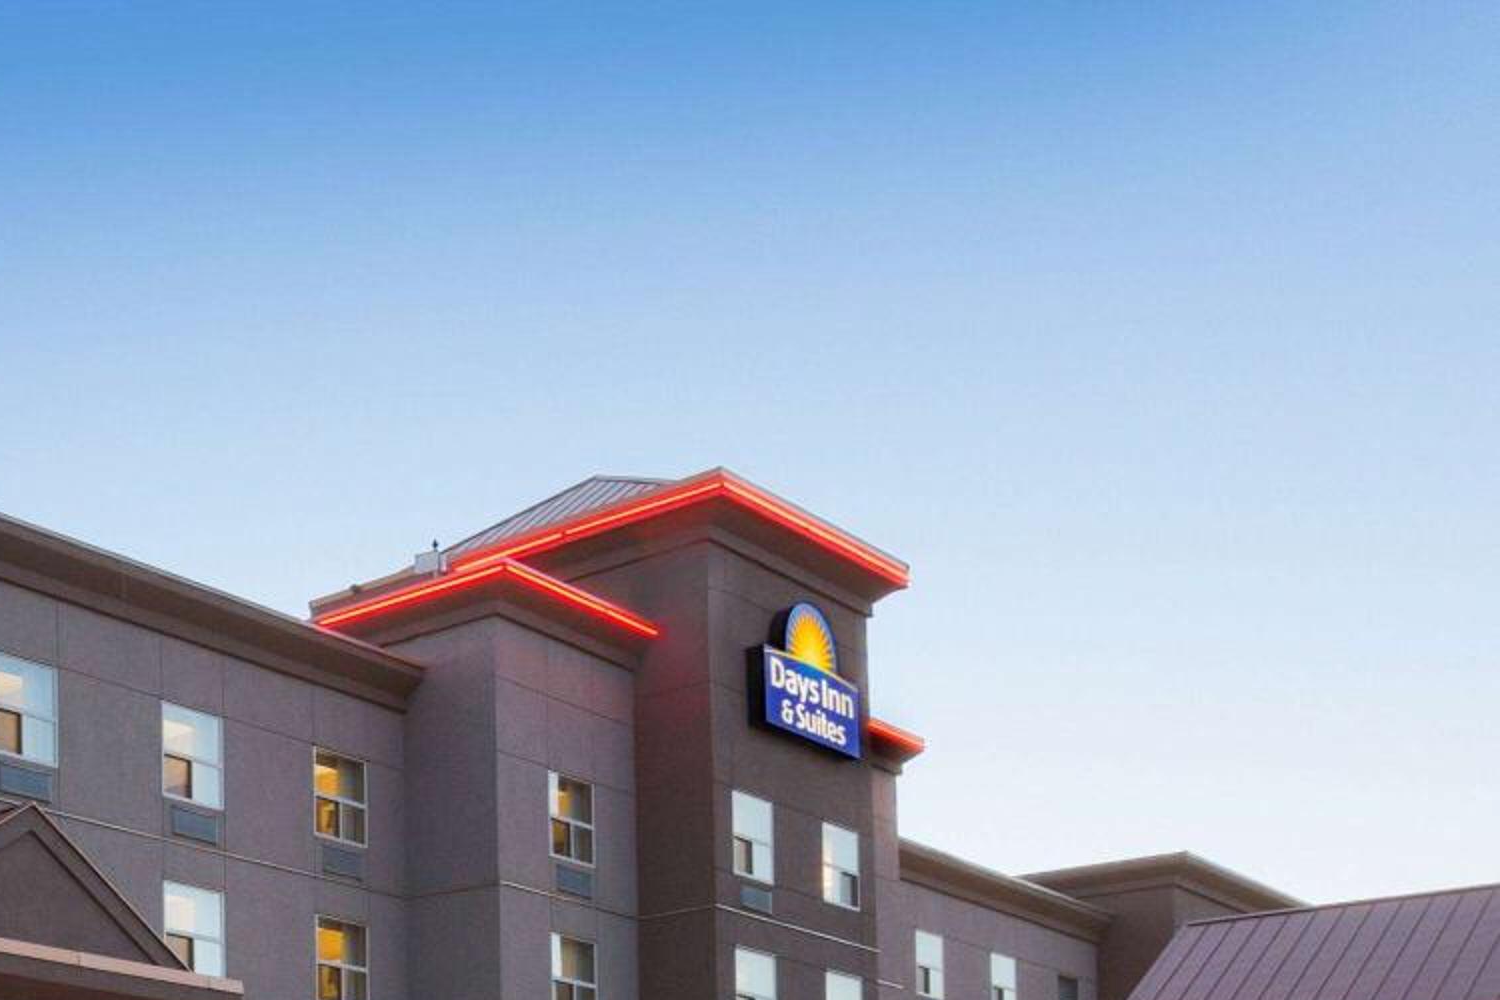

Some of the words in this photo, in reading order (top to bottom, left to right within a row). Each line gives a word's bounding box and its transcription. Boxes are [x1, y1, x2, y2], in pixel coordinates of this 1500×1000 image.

[769, 655, 819, 703] Days
[822, 679, 854, 719] Inn
[781, 699, 794, 725] &
[795, 703, 847, 746] Suites
